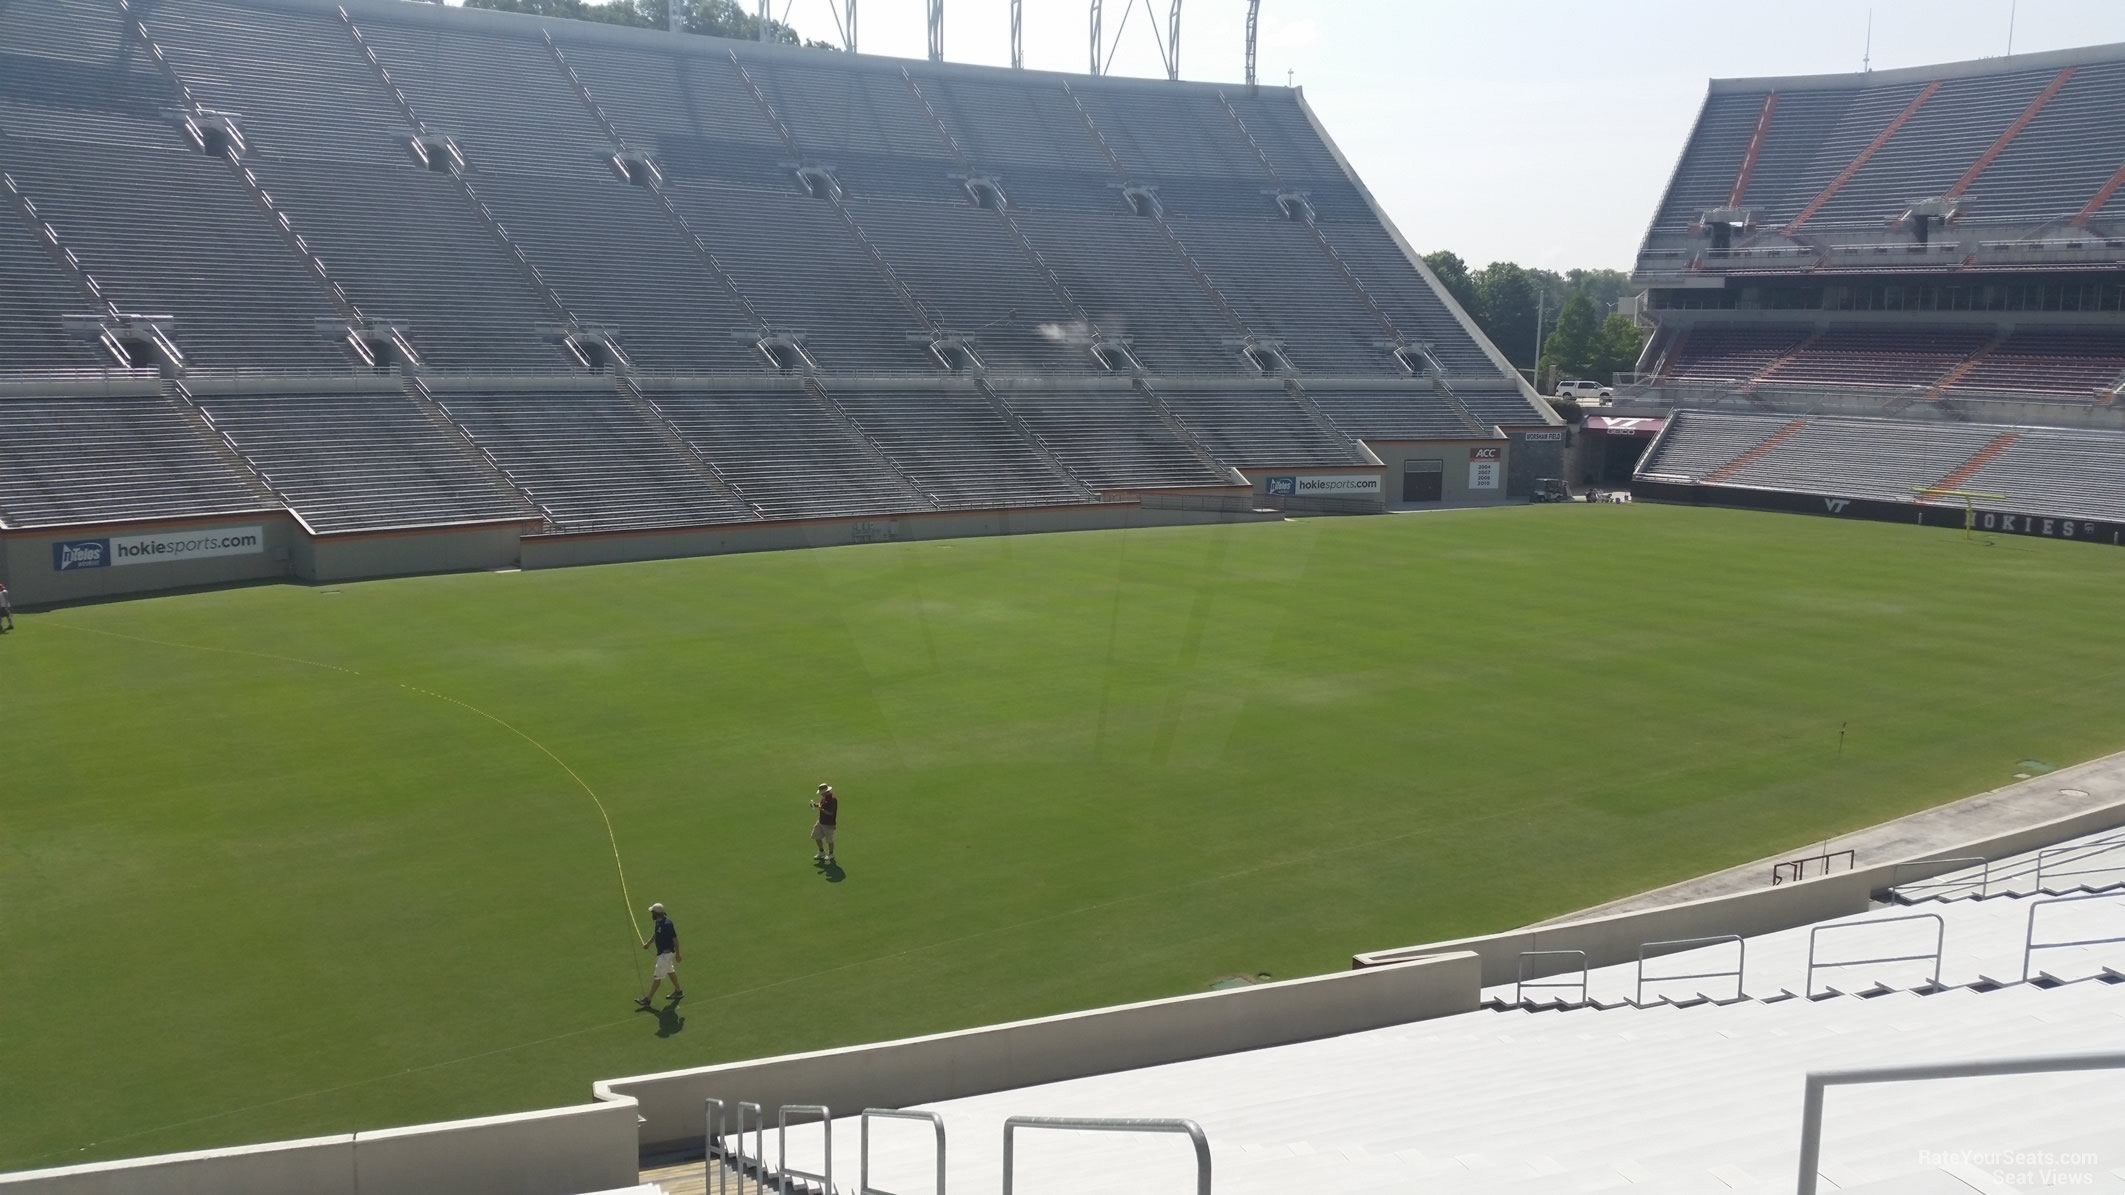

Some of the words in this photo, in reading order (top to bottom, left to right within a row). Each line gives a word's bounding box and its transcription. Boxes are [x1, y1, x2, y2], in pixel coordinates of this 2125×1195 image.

[1601, 416, 1656, 427] VT
[1475, 448, 1496, 458] ACC
[1300, 479, 1377, 491] hokiesports.com
[1824, 498, 1851, 513] VT
[1965, 511, 2074, 537] HOKIES
[117, 534, 257, 557] hokiesports.com
